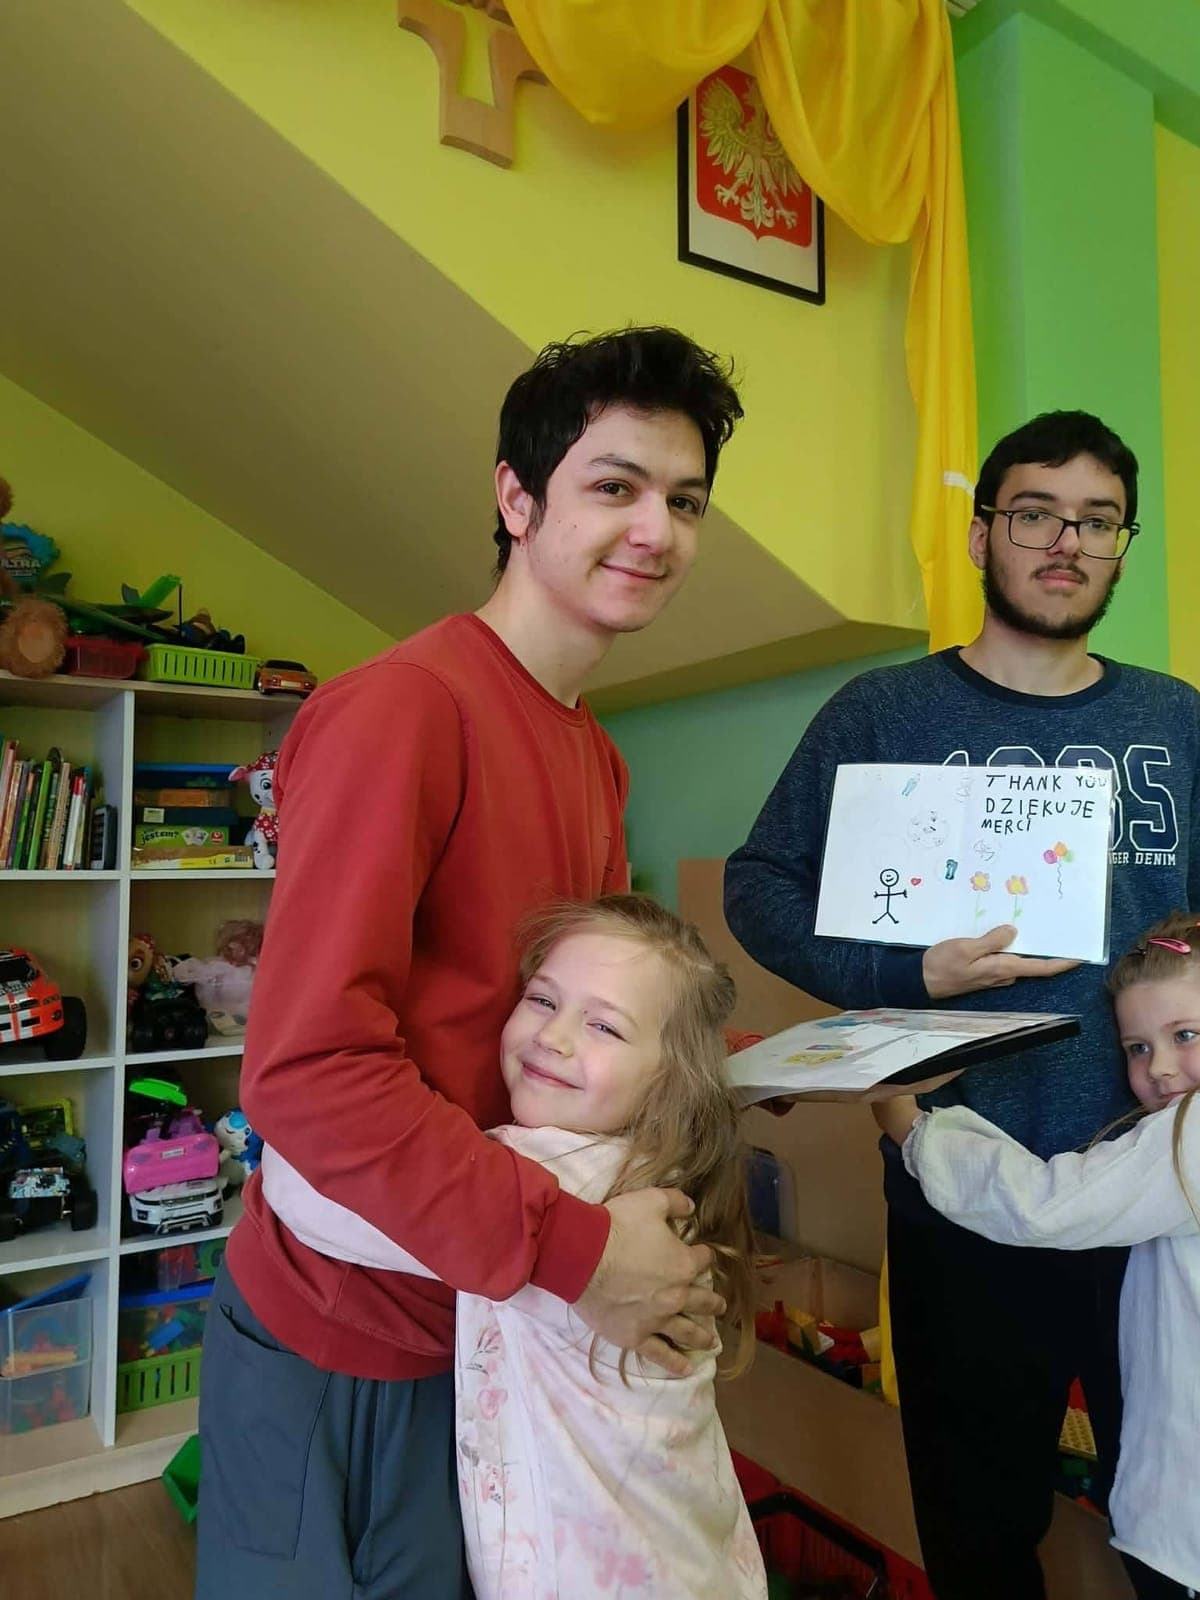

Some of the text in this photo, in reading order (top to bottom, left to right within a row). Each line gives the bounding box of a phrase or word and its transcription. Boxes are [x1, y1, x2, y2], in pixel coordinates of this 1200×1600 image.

[986, 774, 1107, 792] THANK YOU
[981, 818, 1031, 835] MERCI
[1135, 852, 1176, 866] DENIM
